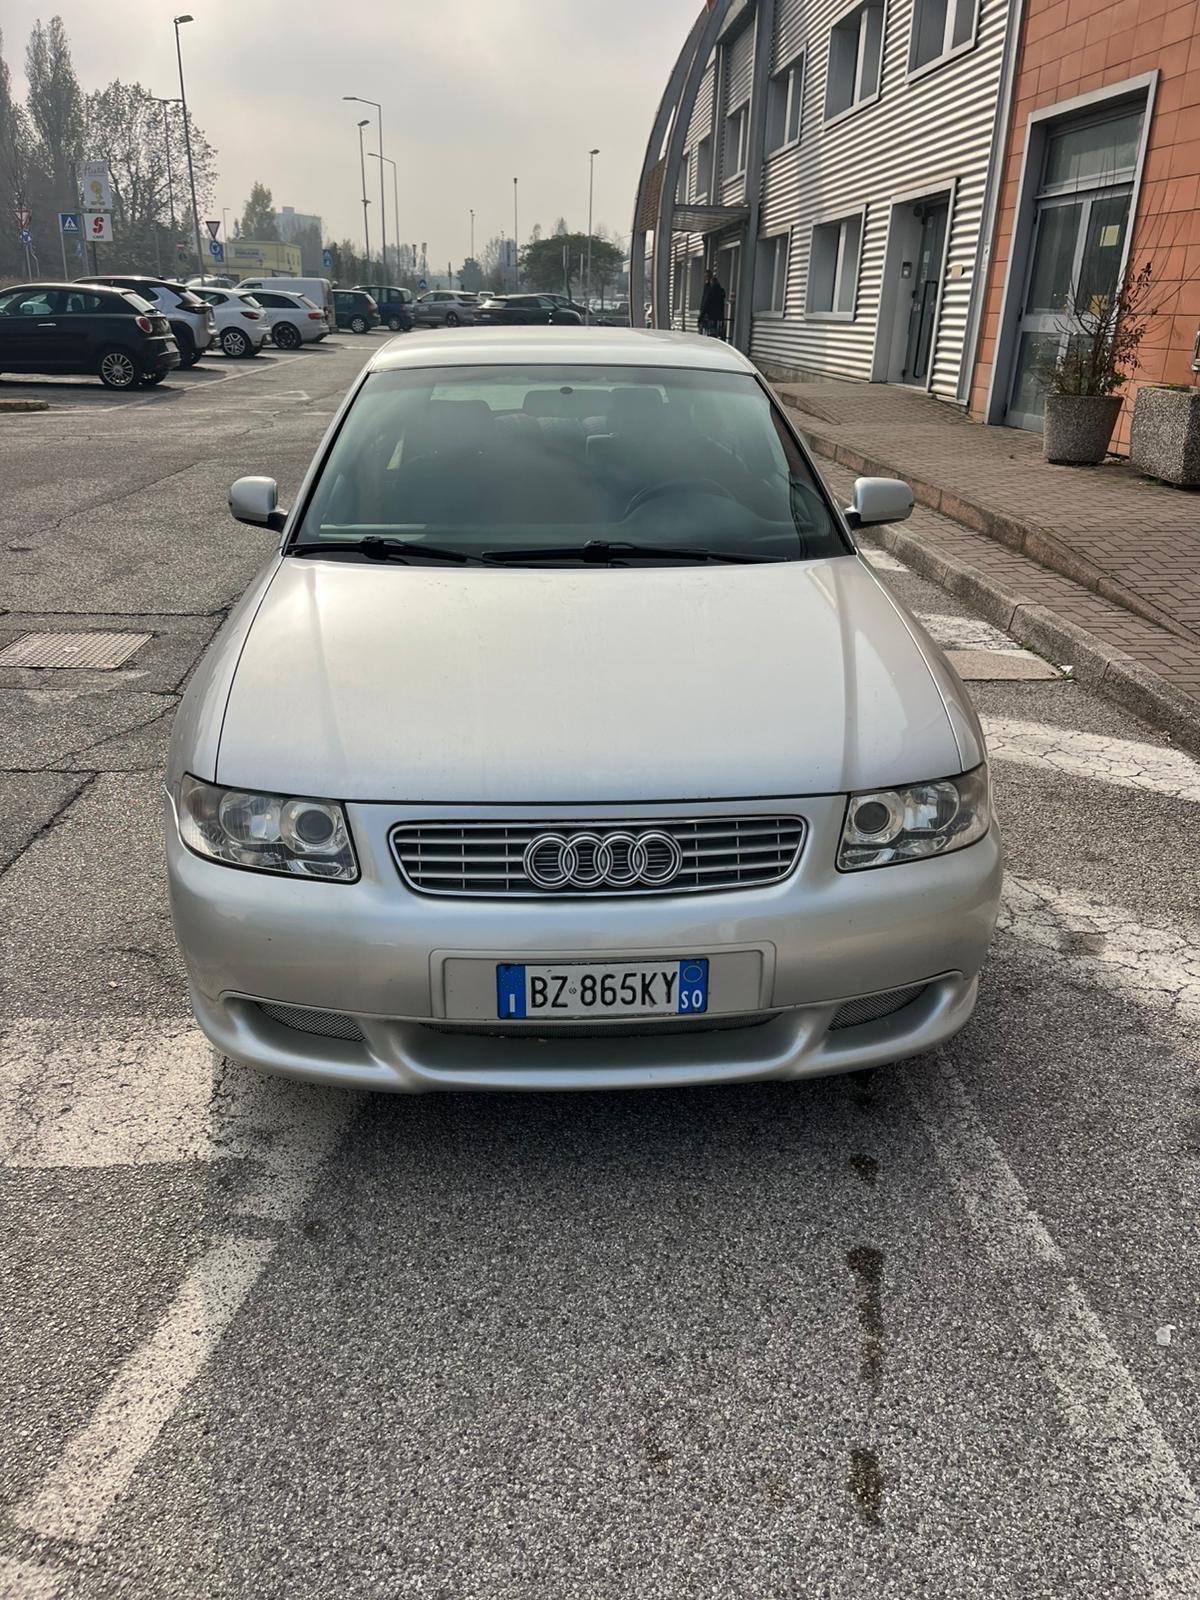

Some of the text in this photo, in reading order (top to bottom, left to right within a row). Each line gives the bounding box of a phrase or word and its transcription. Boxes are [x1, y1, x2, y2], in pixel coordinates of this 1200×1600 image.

[530, 971, 678, 1009] BZ 865KY
[680, 989, 704, 1010] SO
